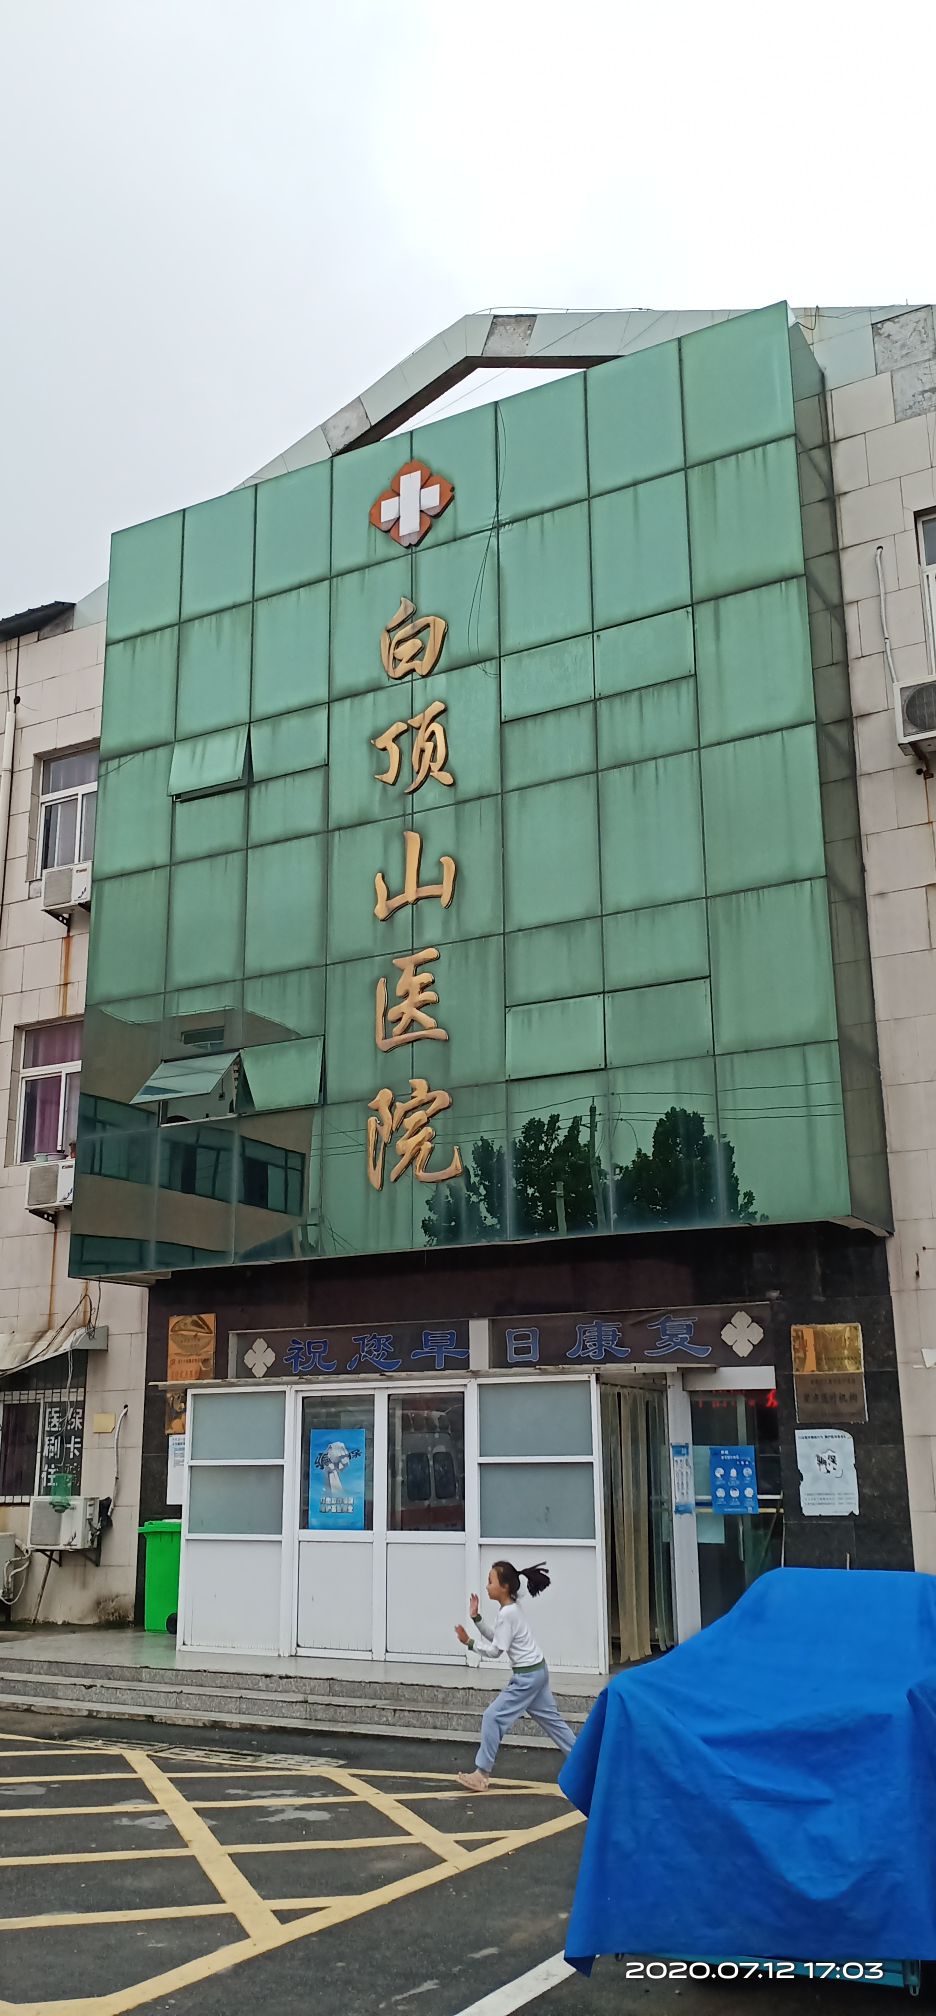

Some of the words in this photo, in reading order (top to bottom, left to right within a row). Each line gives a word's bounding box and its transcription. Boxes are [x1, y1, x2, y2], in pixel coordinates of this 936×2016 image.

[366, 596, 463, 1190] 白顶山医院
[283, 1315, 712, 1374] 祝您早日康复
[45, 1407, 82, 1431] 医保
[43, 1435, 81, 1459] 刷卡
